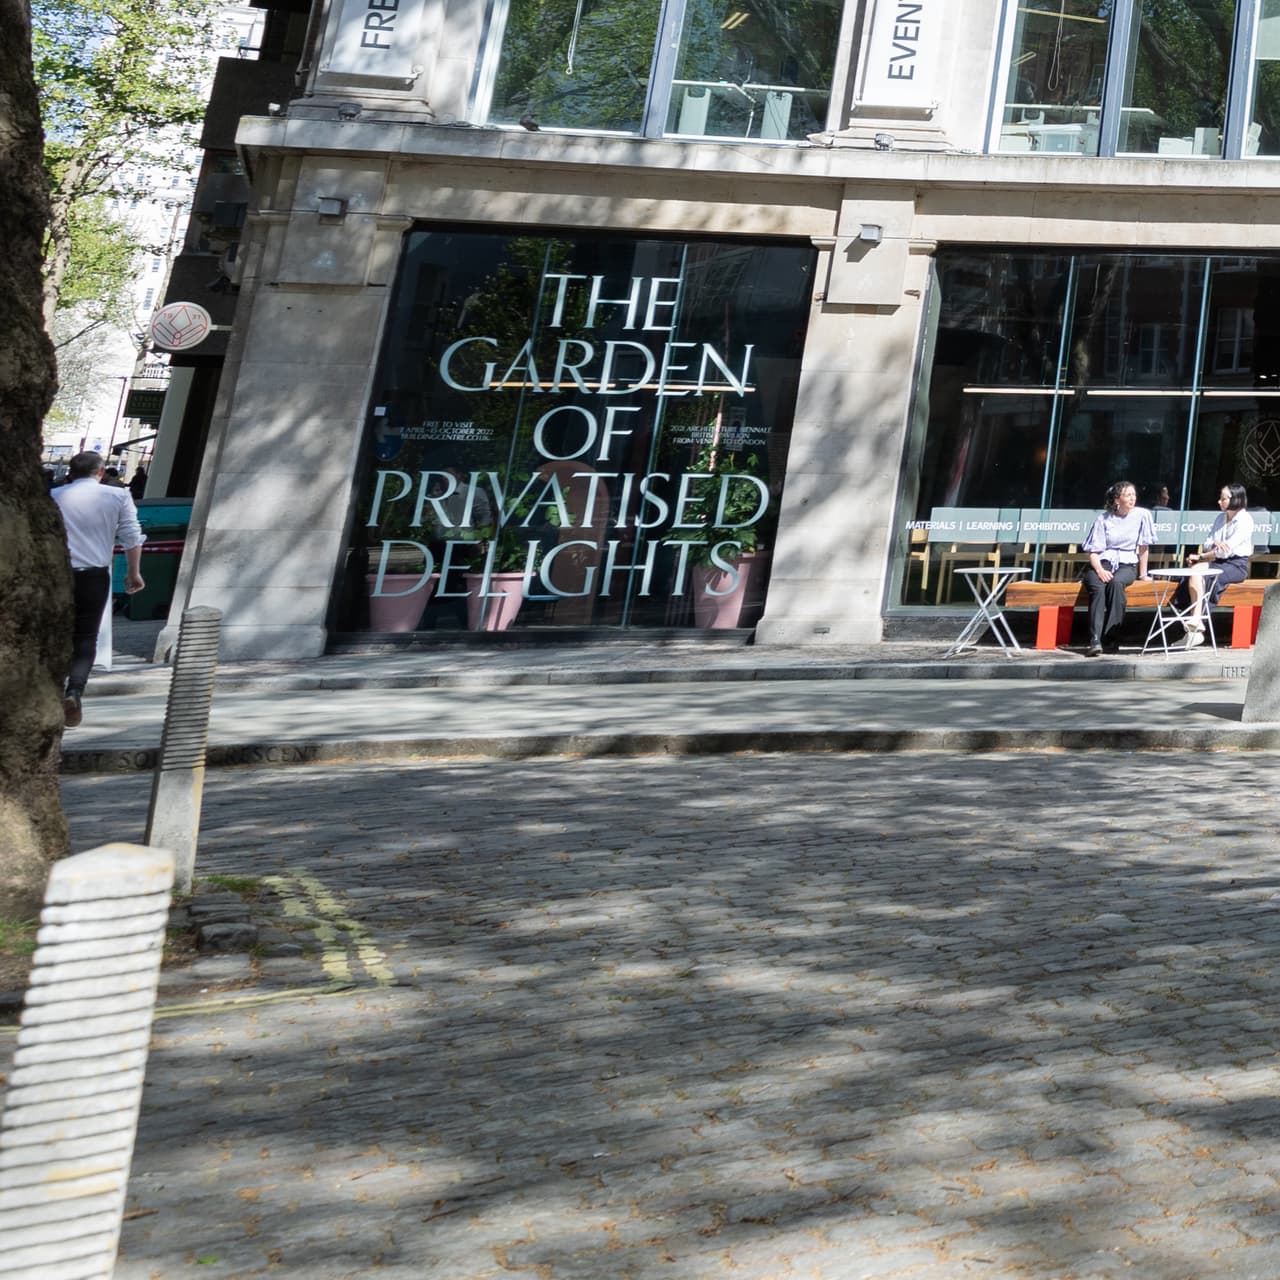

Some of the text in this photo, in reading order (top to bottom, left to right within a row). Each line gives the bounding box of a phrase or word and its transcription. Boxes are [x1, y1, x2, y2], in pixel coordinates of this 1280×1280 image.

[543, 273, 683, 332] THE
[438, 336, 756, 398] GARDEN
[533, 405, 643, 462] OF
[365, 469, 770, 530] PRIVATISED
[905, 520, 1080, 532] MATERIALS LEARNING EXHIBITIONS
[370, 539, 743, 598] DELIGHTS
[1224, 665, 1246, 678] THE
